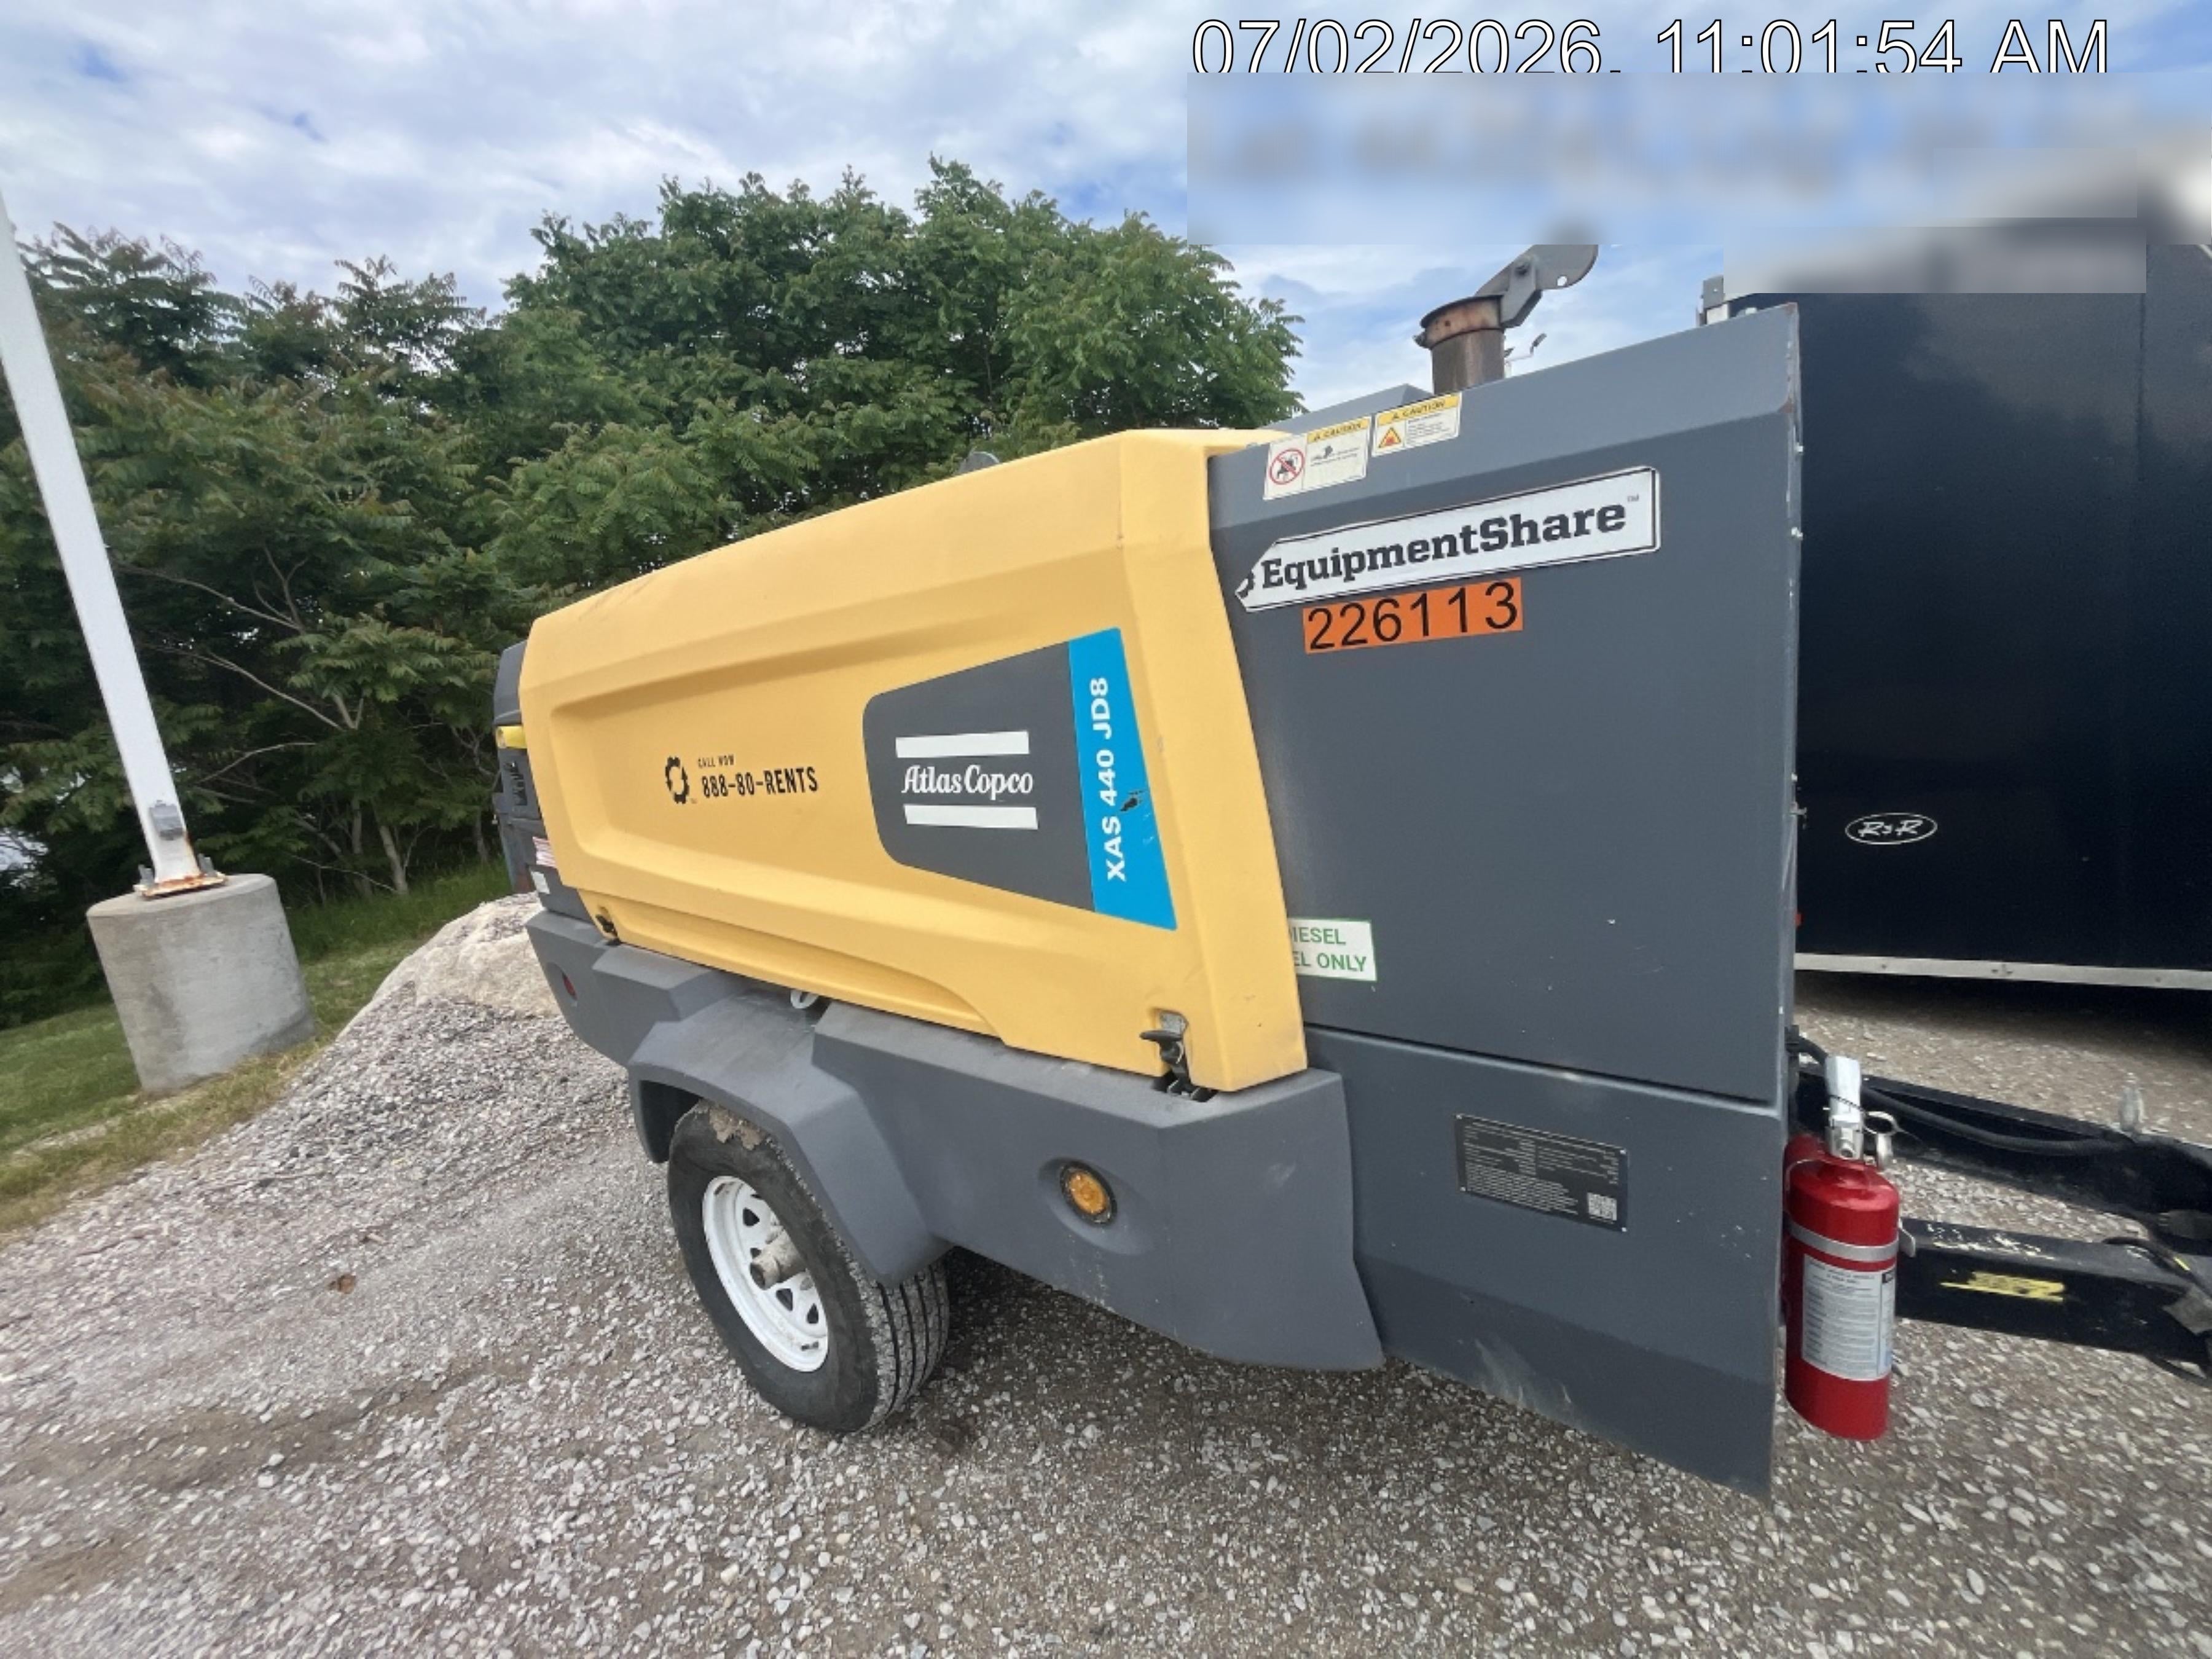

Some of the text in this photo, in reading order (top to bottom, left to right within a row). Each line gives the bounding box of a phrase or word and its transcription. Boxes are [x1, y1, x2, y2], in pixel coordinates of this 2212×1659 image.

[1261, 503, 1626, 591] EquipmentShare
[1308, 582, 1518, 650] 226113
[702, 767, 818, 798] 888-80-RENTS
[901, 764, 1033, 801] Atlas Copco
[1089, 677, 1126, 882] XAS 440 JD8
[1290, 926, 1346, 945] IESEL
[1317, 952, 1367, 972] ONLY
